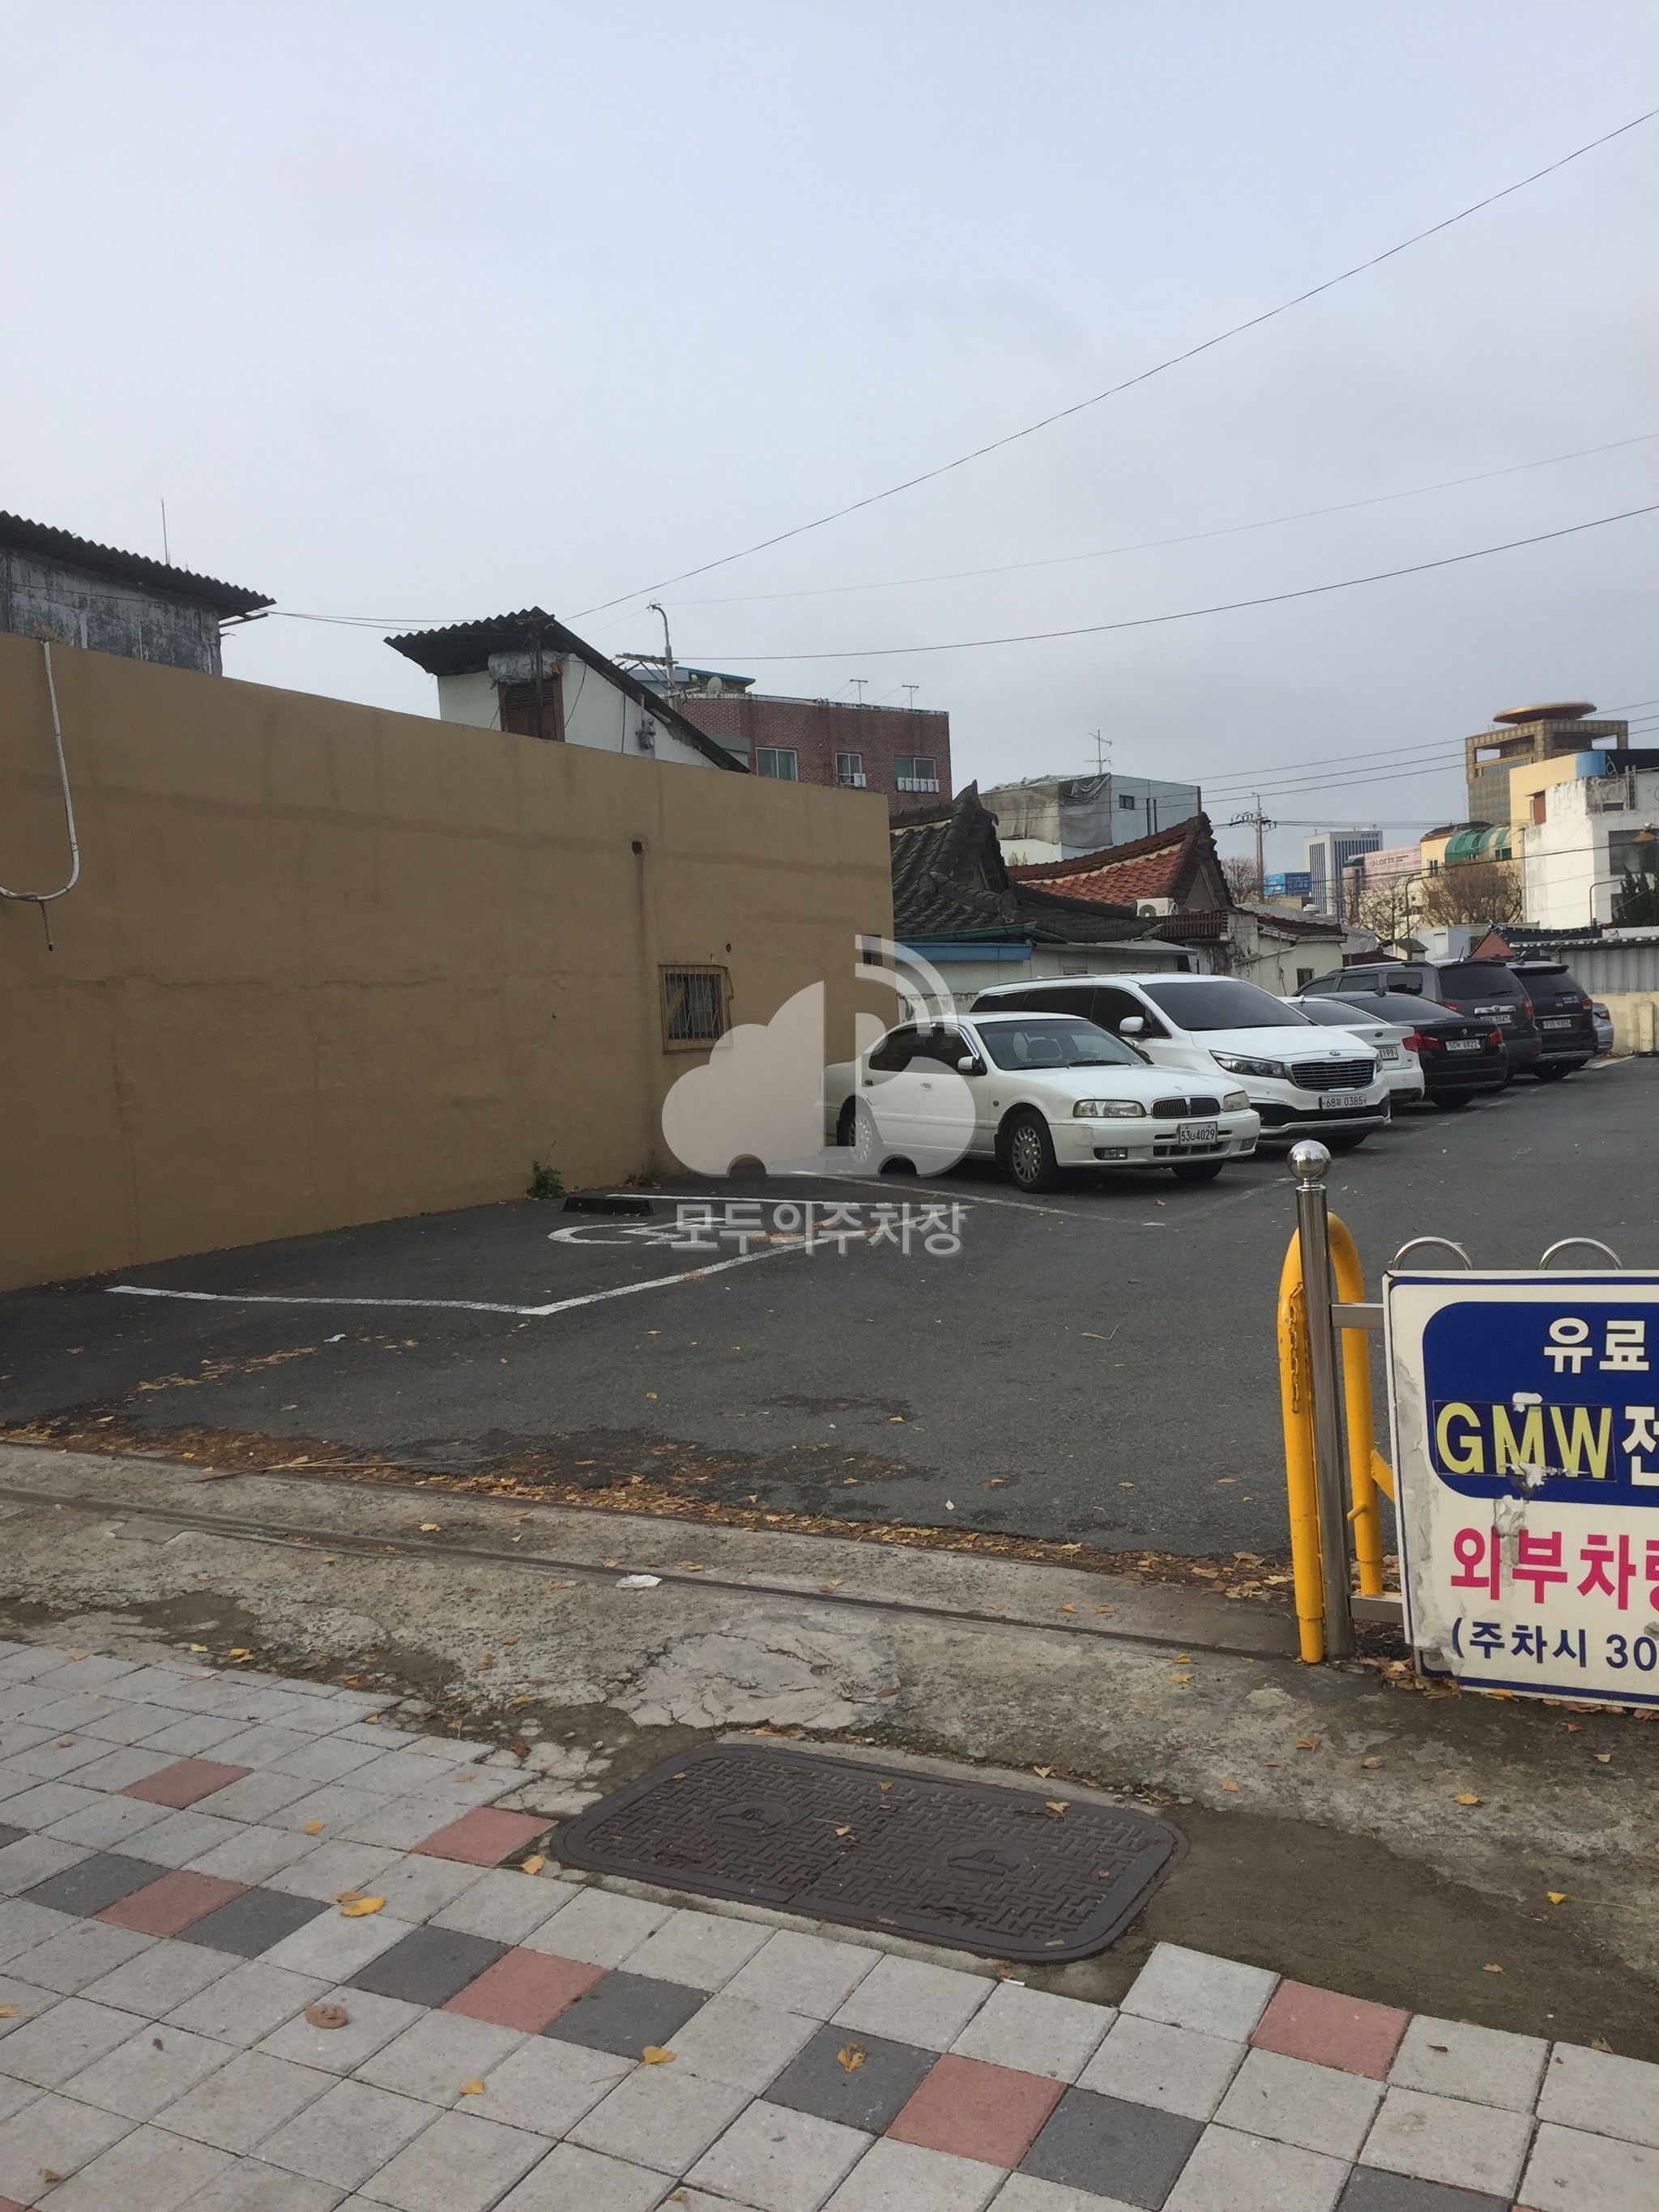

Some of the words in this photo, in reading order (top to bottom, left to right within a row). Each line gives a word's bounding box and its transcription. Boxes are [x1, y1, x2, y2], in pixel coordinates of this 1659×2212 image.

[1375, 857, 1395, 865] LOTTE
[1344, 1096, 1363, 1106] 0385
[1543, 1317, 1650, 1374] 유료
[1452, 1617, 1587, 1668] (주차시
